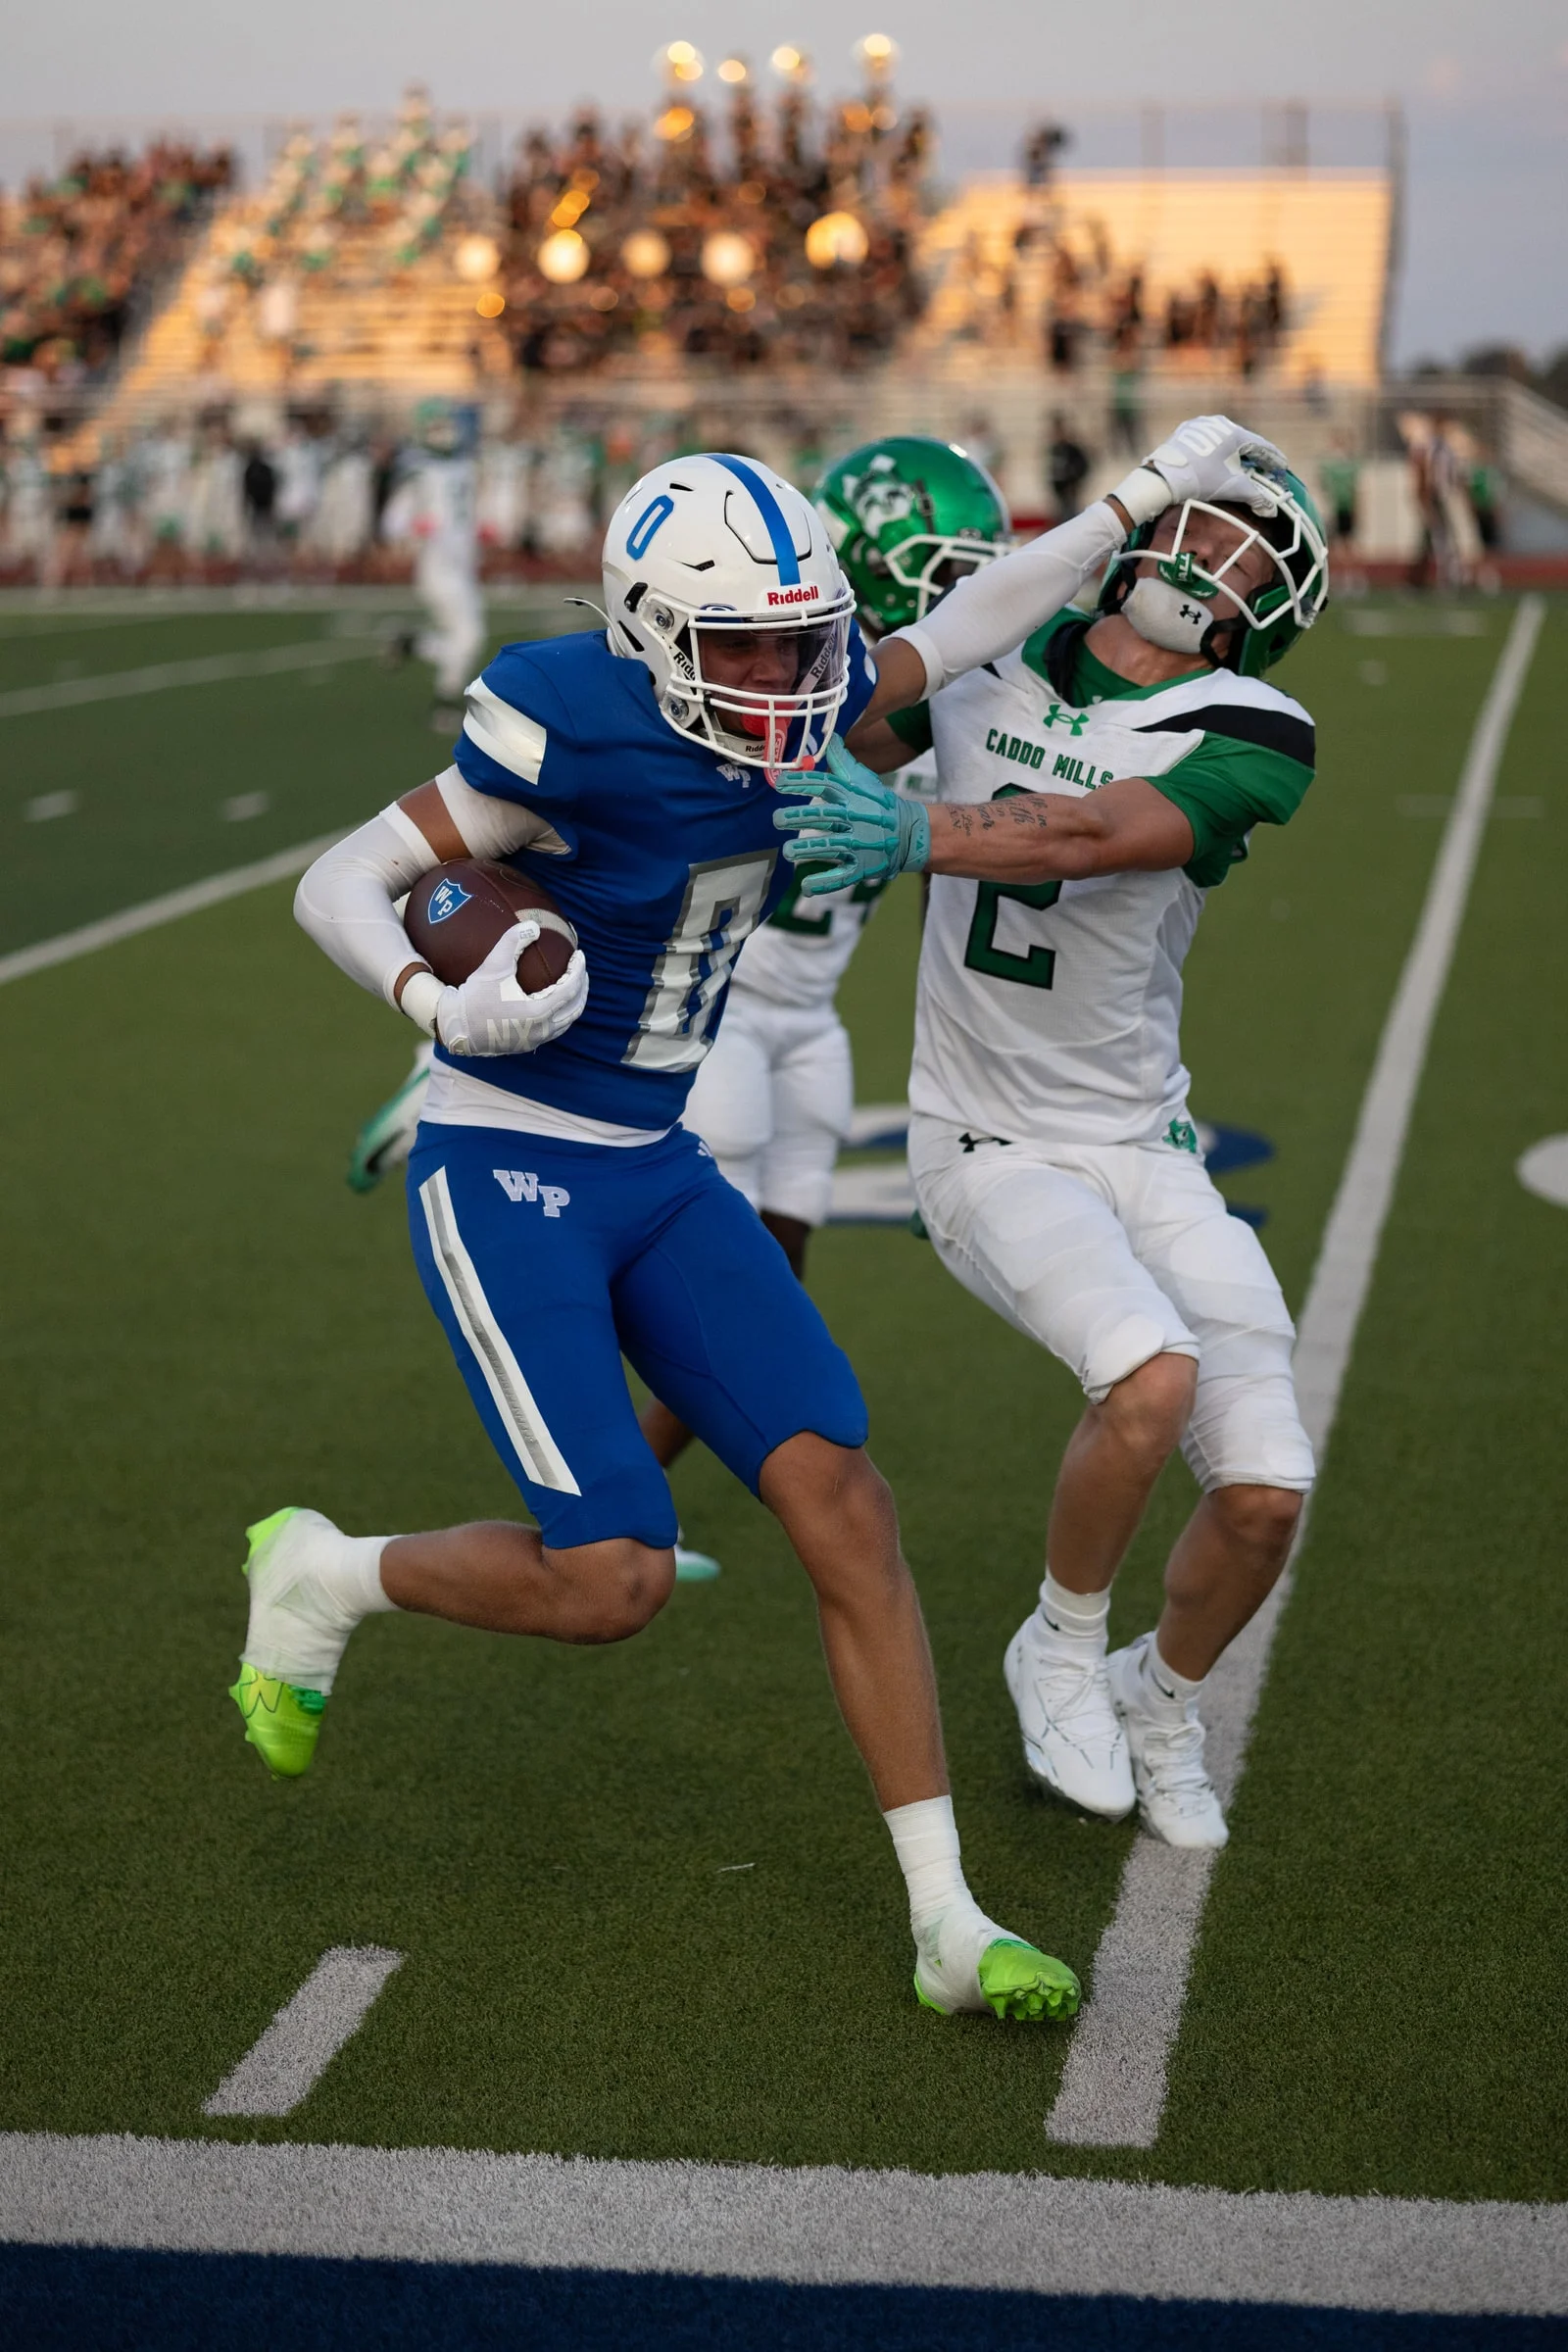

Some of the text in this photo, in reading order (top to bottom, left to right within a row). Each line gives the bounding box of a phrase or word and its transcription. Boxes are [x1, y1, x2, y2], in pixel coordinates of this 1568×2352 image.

[626, 494, 674, 562] 0
[767, 586, 819, 606] Riddell
[673, 652, 696, 680] Ridd
[986, 728, 1113, 791] CADDO MILLS
[434, 886, 454, 916] WP
[964, 783, 1063, 991] 2
[621, 847, 779, 1073] 0
[493, 1169, 571, 1218] WP
